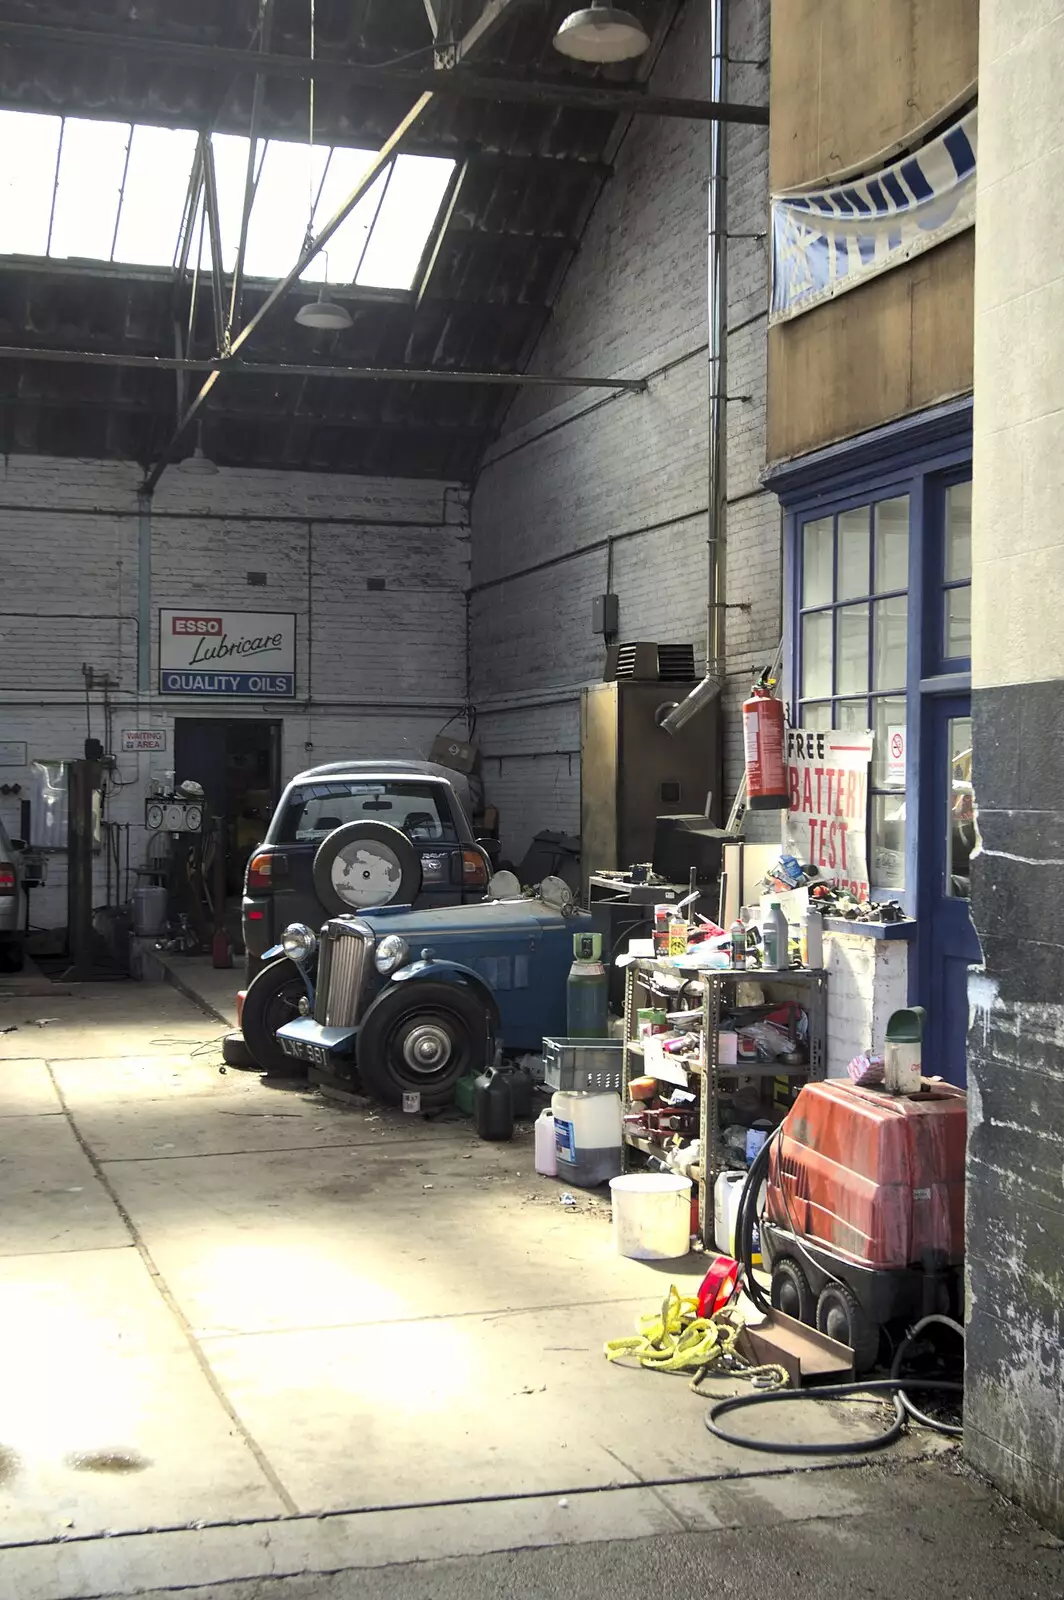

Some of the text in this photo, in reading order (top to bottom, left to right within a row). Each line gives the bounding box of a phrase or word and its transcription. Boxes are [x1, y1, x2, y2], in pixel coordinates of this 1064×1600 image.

[175, 620, 219, 633] ESSO
[188, 633, 283, 666] Lubricare
[167, 675, 287, 692] QUALITY OILS
[126, 732, 162, 740] WAITING
[137, 740, 160, 748] AREA
[788, 733, 825, 760] FREE
[789, 766, 865, 819] BATTERY
[808, 818, 849, 870] TEST
[832, 877, 868, 903] RE
[280, 1038, 328, 1066] LXF 981
